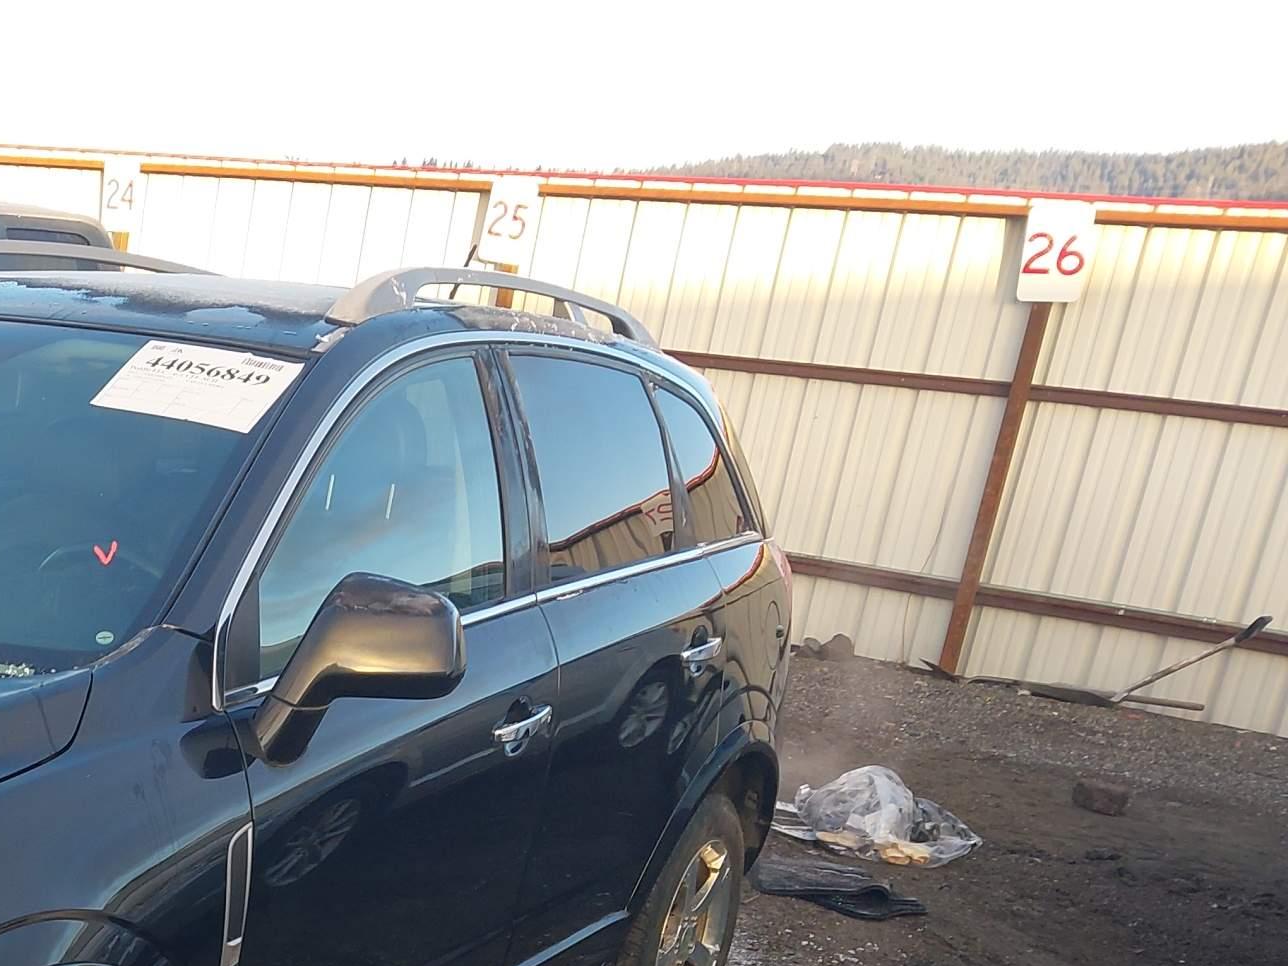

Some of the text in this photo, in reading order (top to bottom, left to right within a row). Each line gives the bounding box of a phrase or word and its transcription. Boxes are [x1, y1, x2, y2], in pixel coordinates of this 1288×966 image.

[106, 178, 134, 211] 24
[487, 200, 529, 241] 25
[1021, 232, 1086, 277] 26
[145, 356, 272, 387] 44056849
